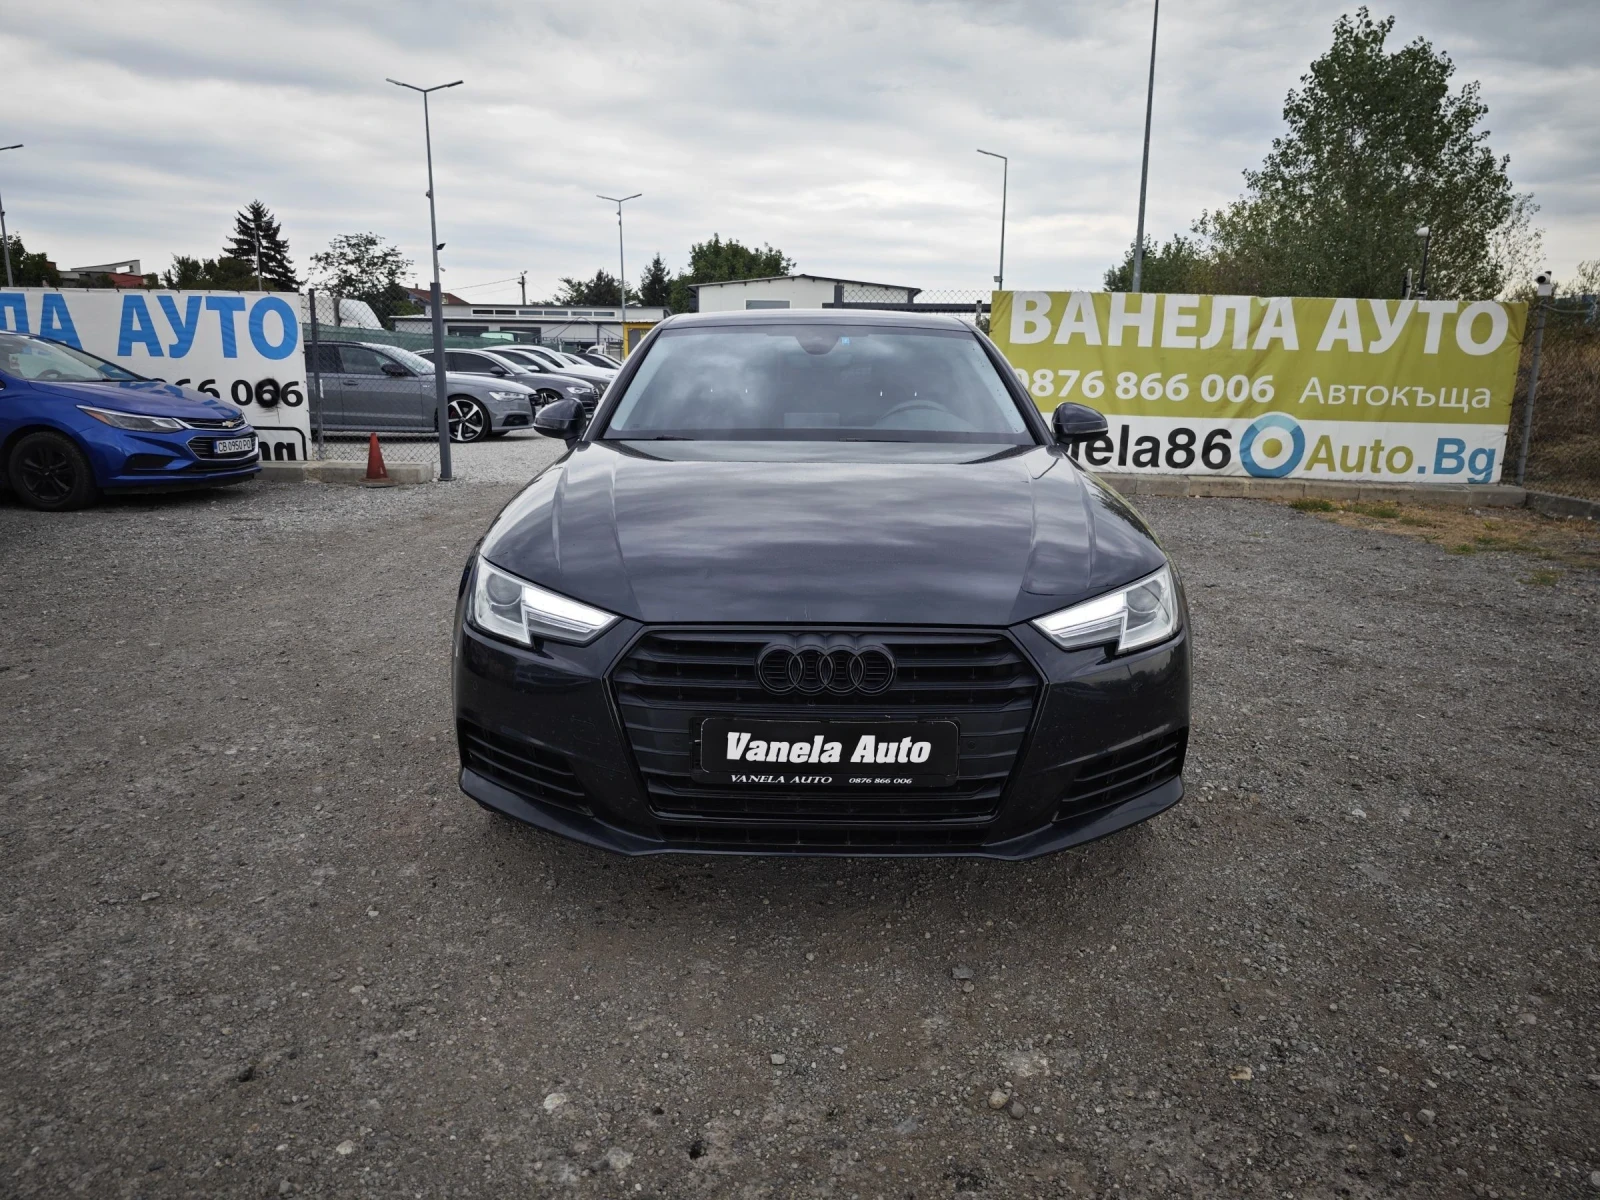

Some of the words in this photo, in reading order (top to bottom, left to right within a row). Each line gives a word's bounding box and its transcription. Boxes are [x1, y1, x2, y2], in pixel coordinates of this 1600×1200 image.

[117, 294, 298, 360] АУТО
[1010, 291, 1299, 350] ВАНЕЛА
[1316, 298, 1509, 356] АУТО
[1115, 371, 1189, 401] 866
[1200, 373, 1275, 403] 006
[1299, 377, 1491, 413] Автокъща
[219, 442, 227, 452] CB
[1304, 434, 1496, 484] Auto.Bg
[726, 732, 842, 763] Vanela
[850, 735, 931, 764] Auto
[731, 774, 785, 783] VANELA
[790, 775, 833, 784] AUTO
